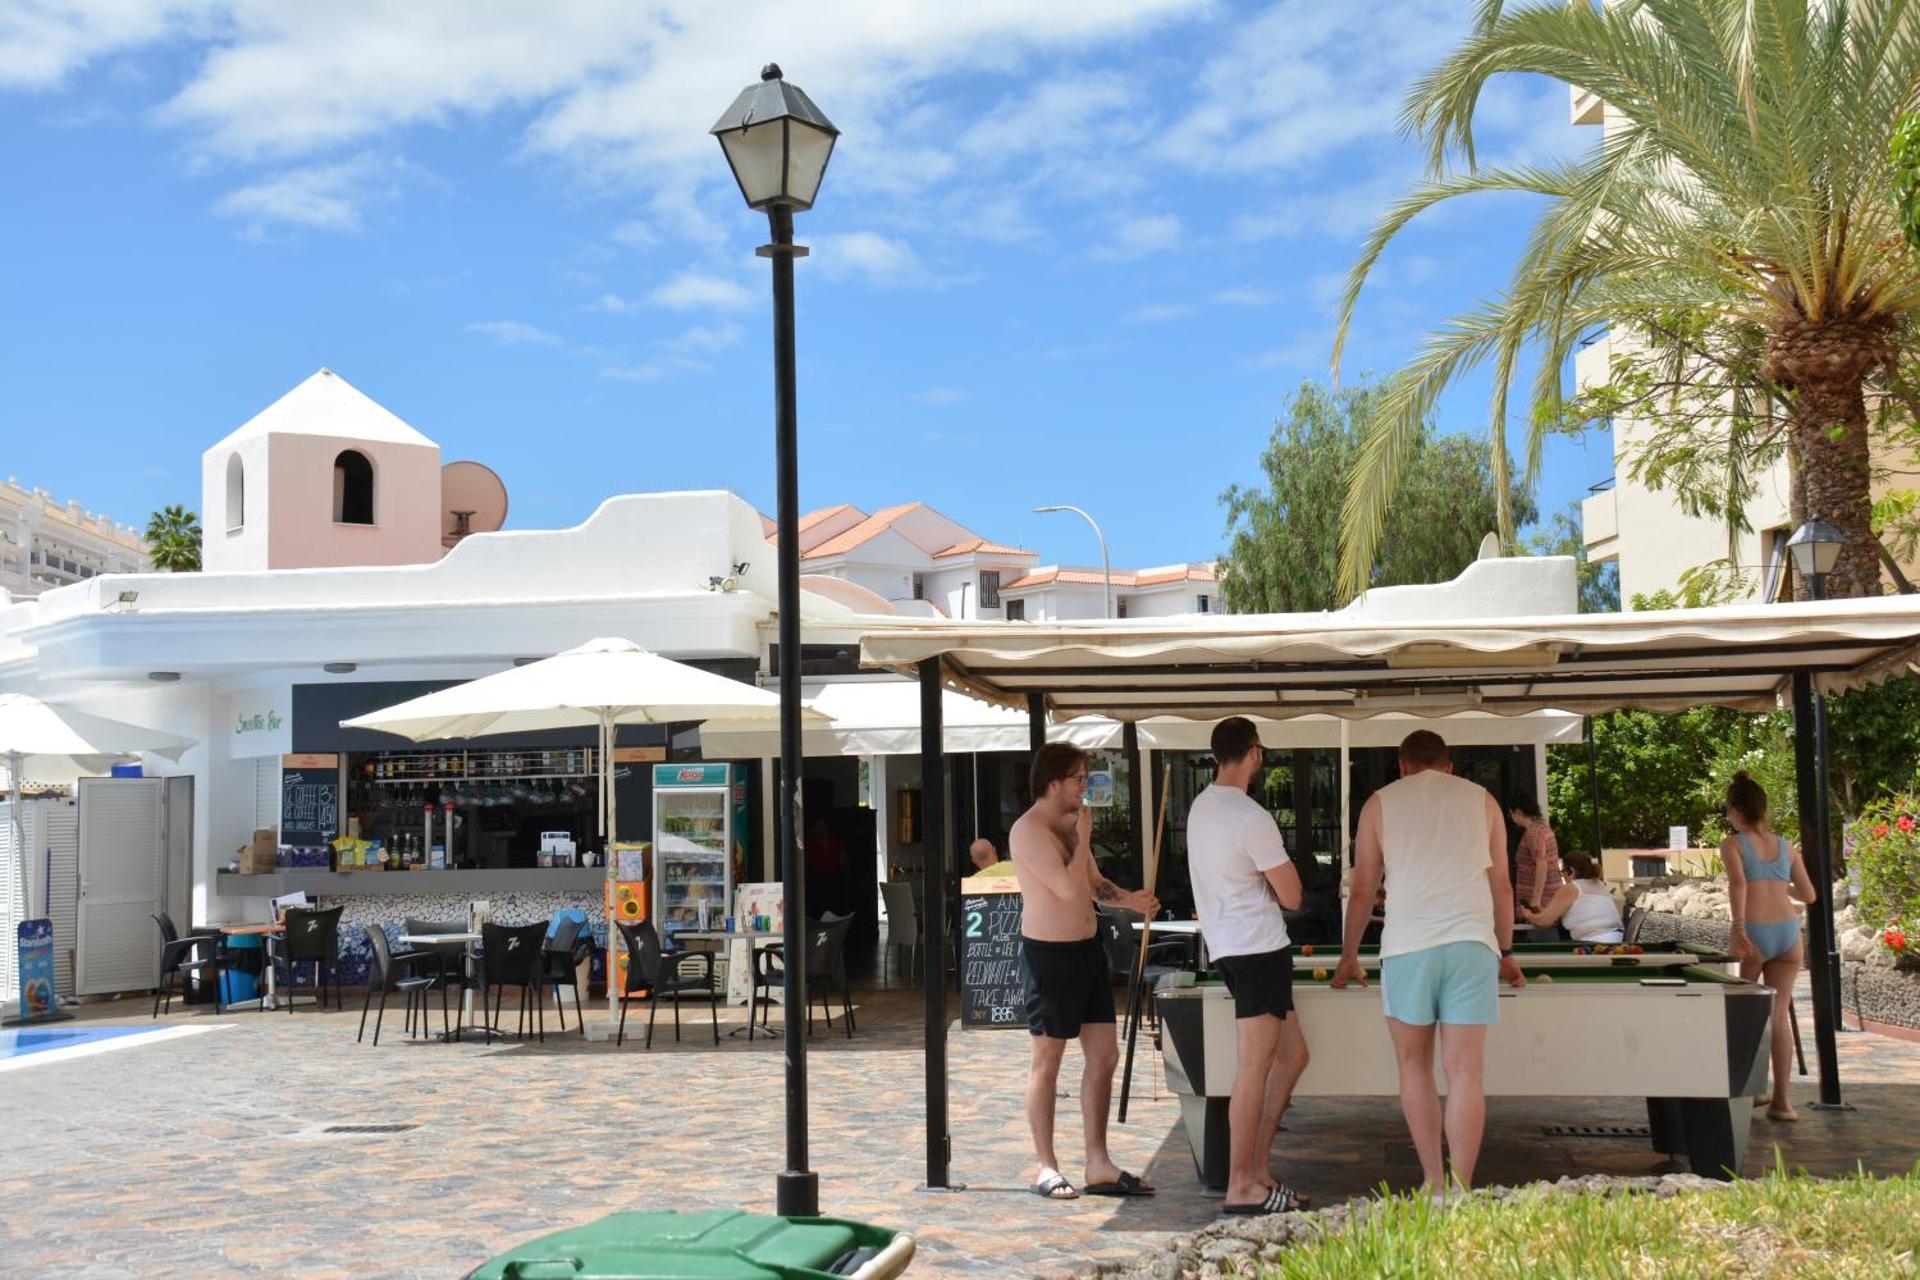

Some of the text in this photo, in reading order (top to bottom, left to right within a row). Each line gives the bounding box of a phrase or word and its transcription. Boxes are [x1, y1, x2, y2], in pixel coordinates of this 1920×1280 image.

[967, 911, 983, 938] 2
[972, 988, 1025, 1007] TAKE AWA
